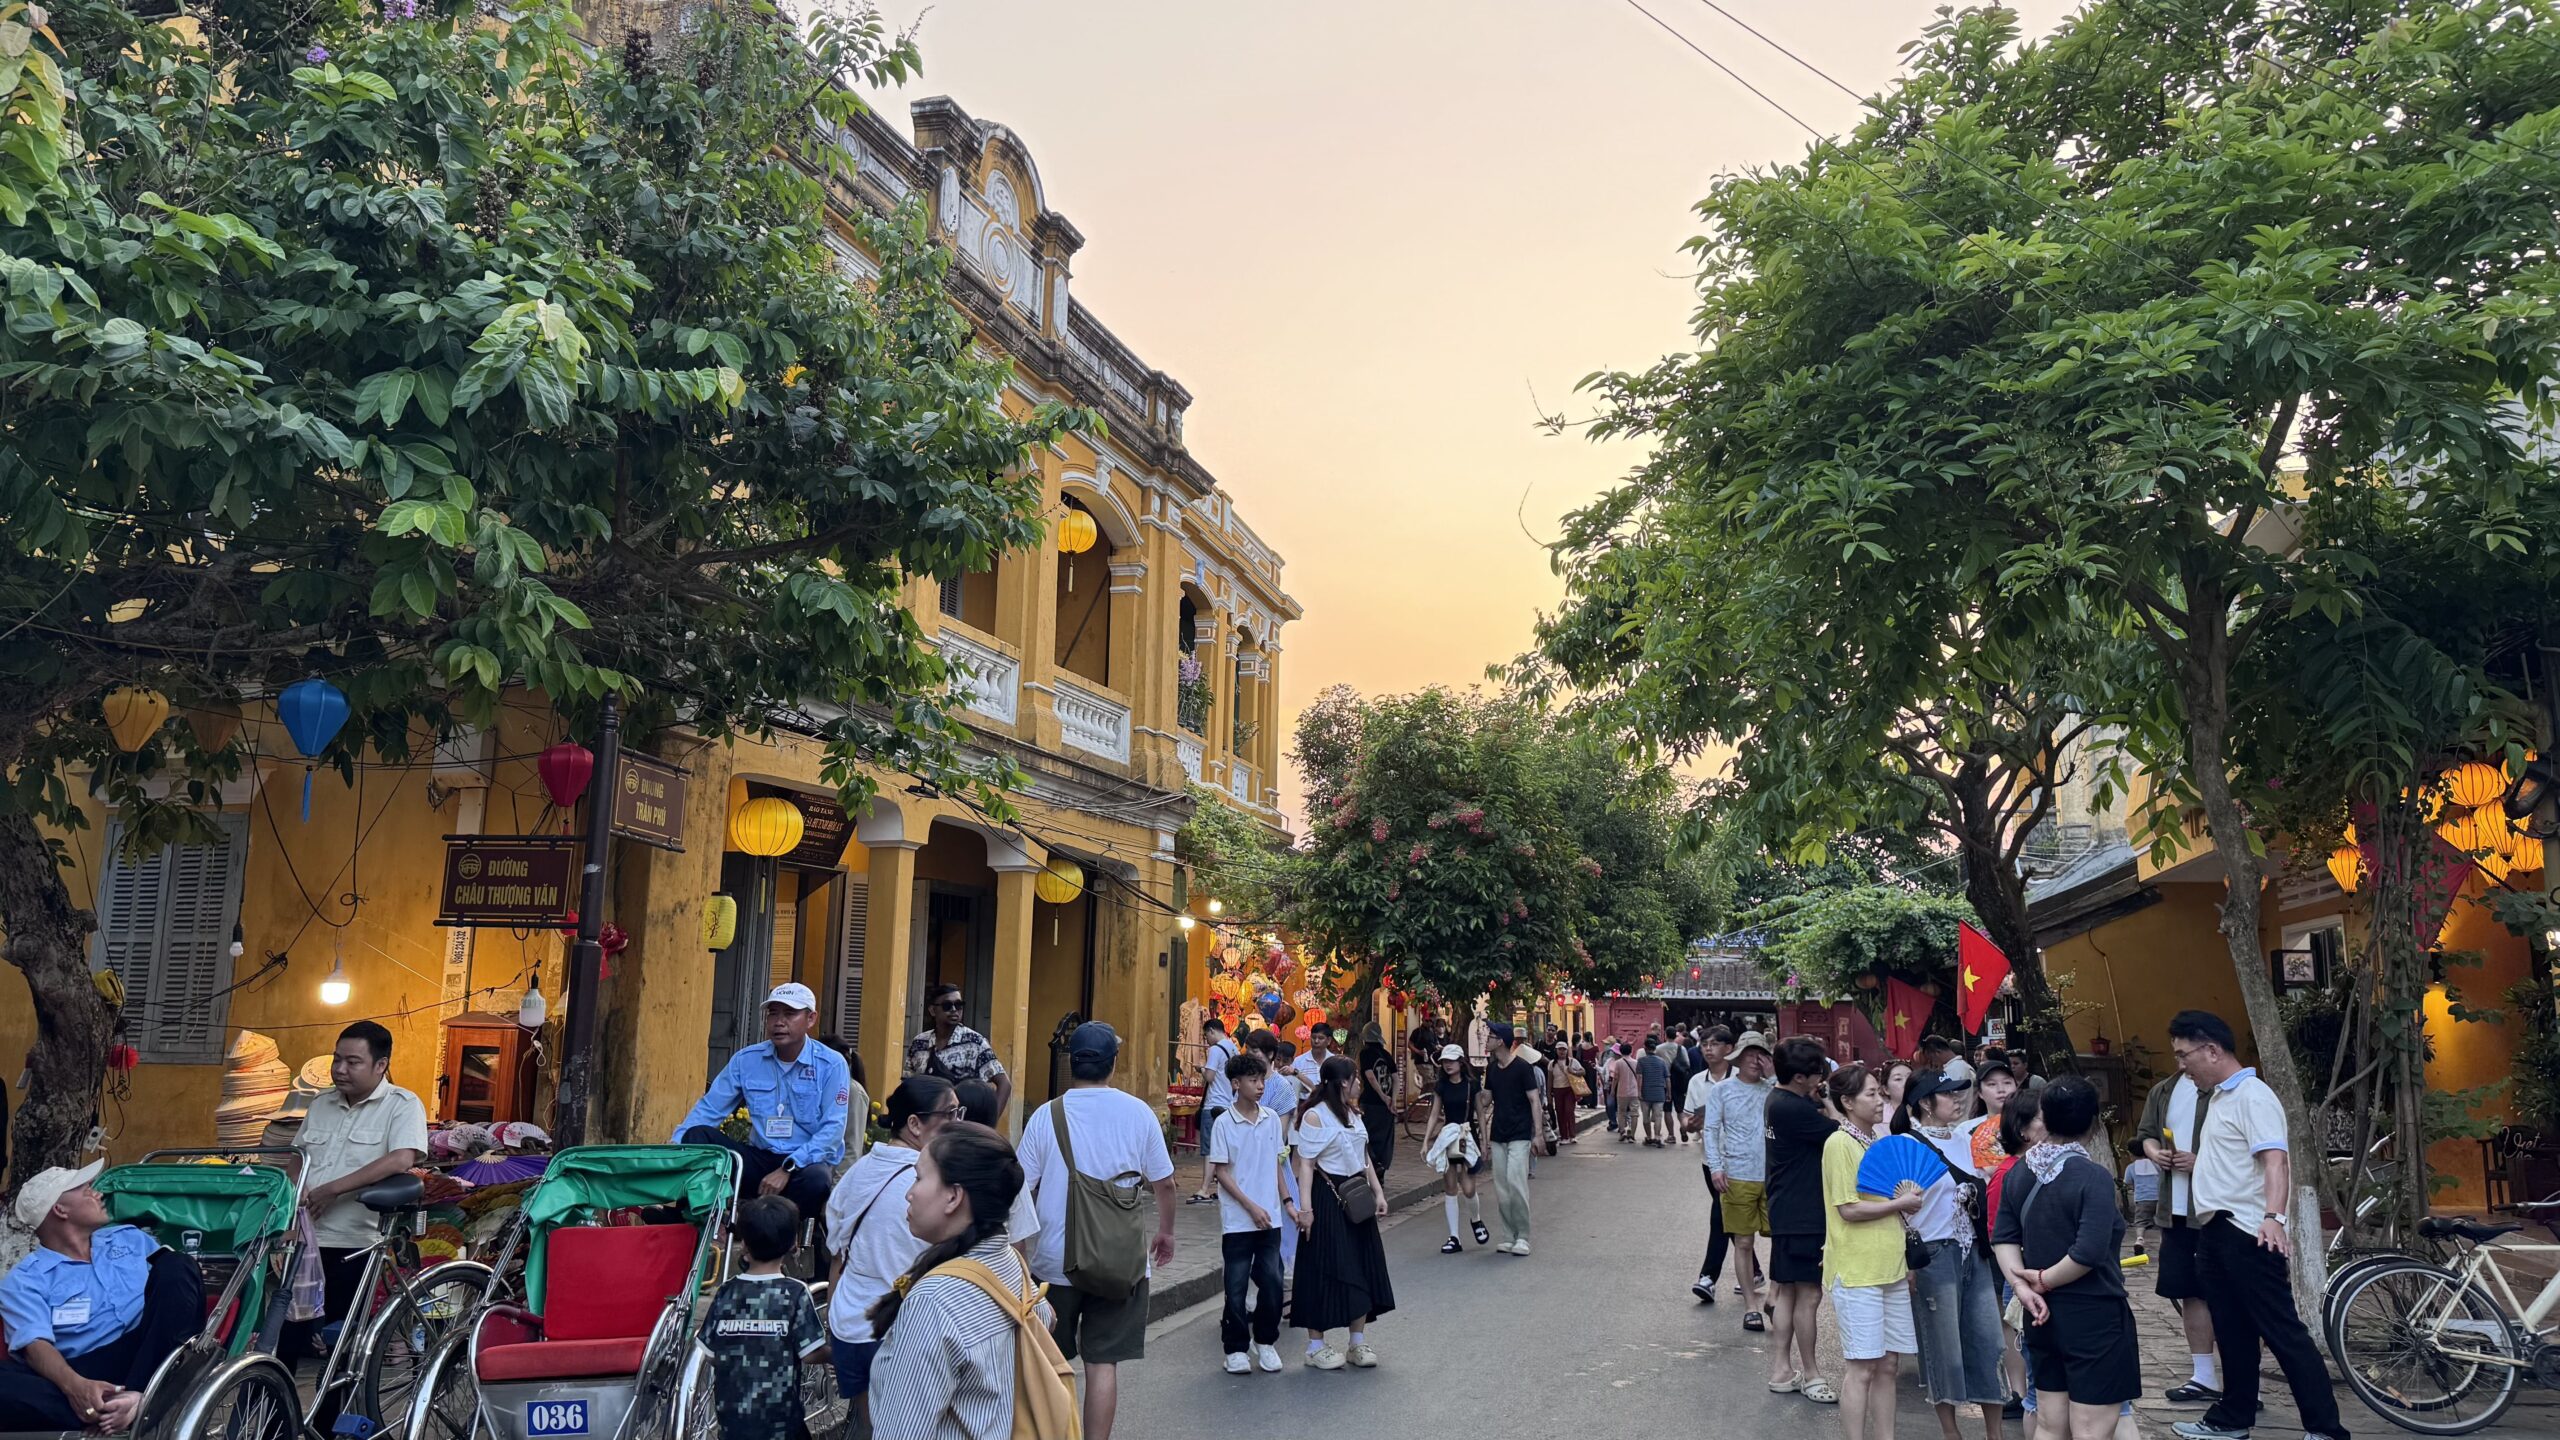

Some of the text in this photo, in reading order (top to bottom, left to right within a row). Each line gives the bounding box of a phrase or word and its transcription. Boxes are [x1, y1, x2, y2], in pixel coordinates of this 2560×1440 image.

[636, 798, 667, 827] TRẦN PHÚ
[488, 856, 528, 877] ĐƯỜNG
[454, 882, 558, 909] CHÂU THƯỢNG VĂN
[717, 1319, 789, 1336] MINECRAFT
[532, 1404, 584, 1431] 036
